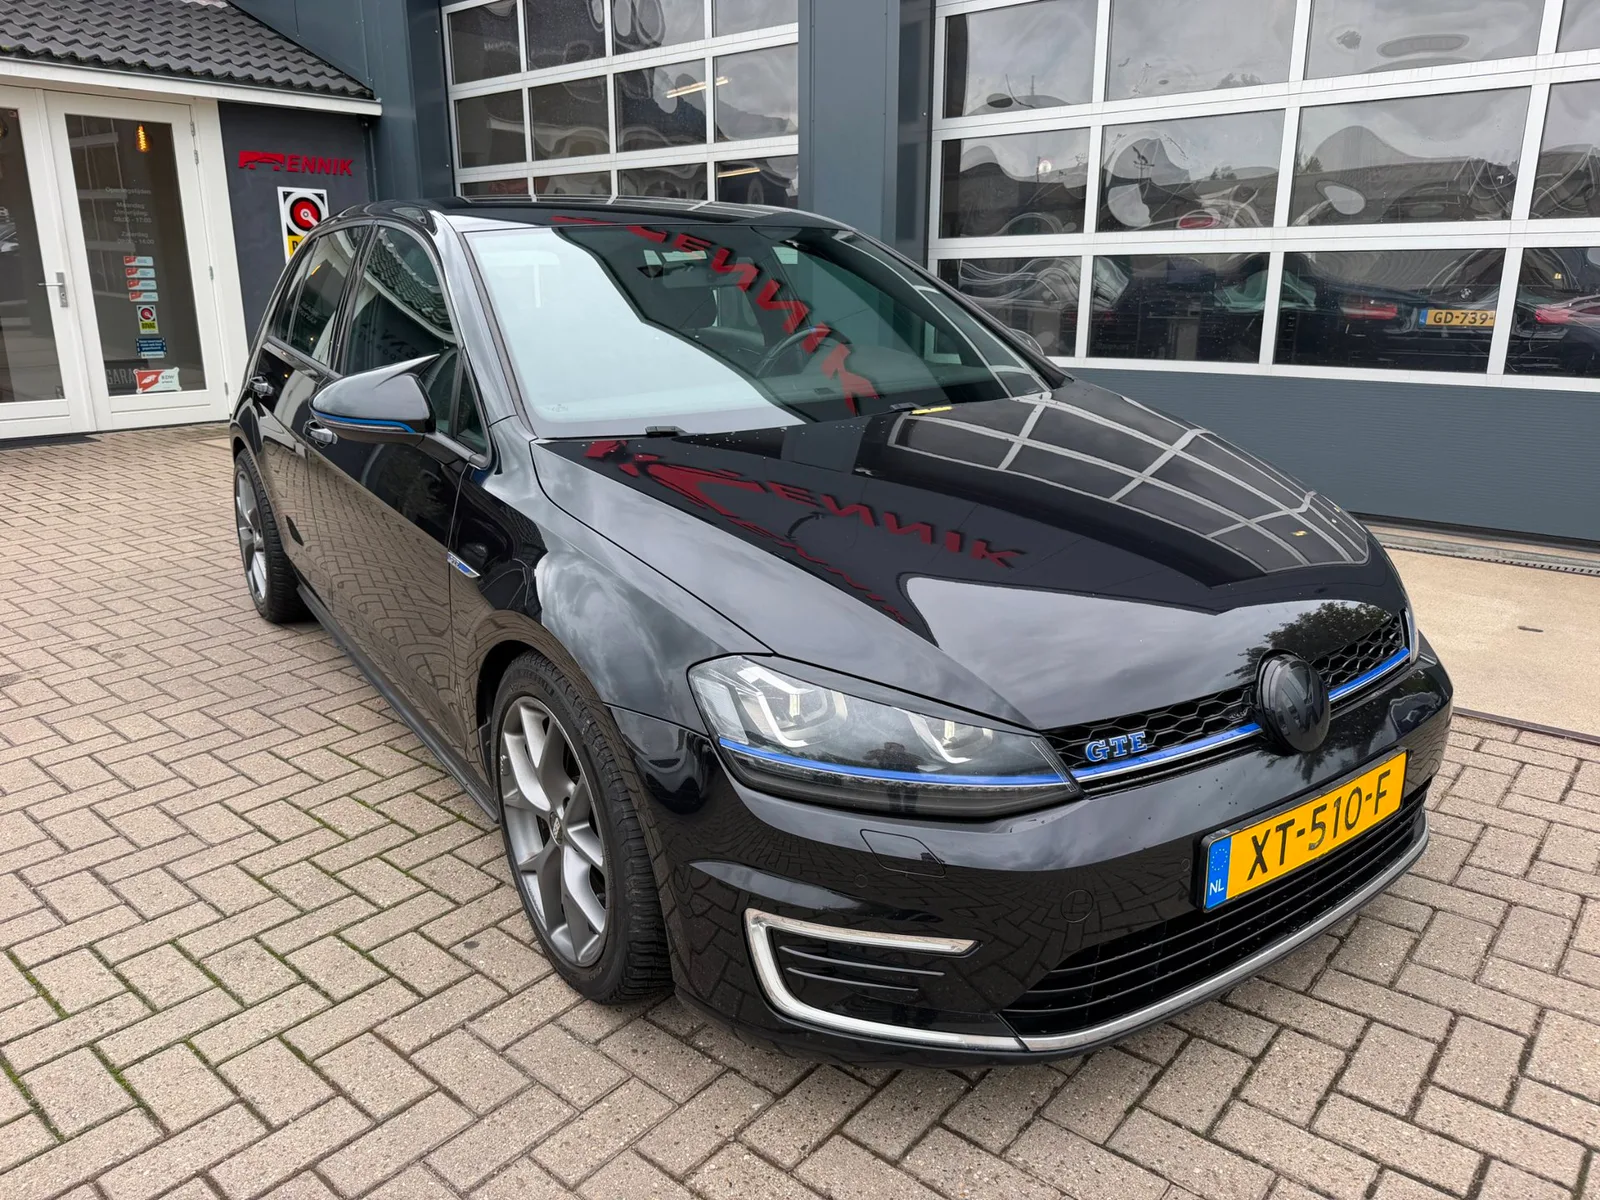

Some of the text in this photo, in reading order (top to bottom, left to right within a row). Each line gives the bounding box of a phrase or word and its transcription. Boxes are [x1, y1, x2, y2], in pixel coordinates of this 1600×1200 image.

[286, 154, 353, 176] ENNIK
[1433, 312, 1494, 325] GD-739-
[106, 368, 136, 385] GARA
[1085, 731, 1148, 762] GTE
[1246, 769, 1391, 881] XT-510-F
[1209, 879, 1225, 896] NL
